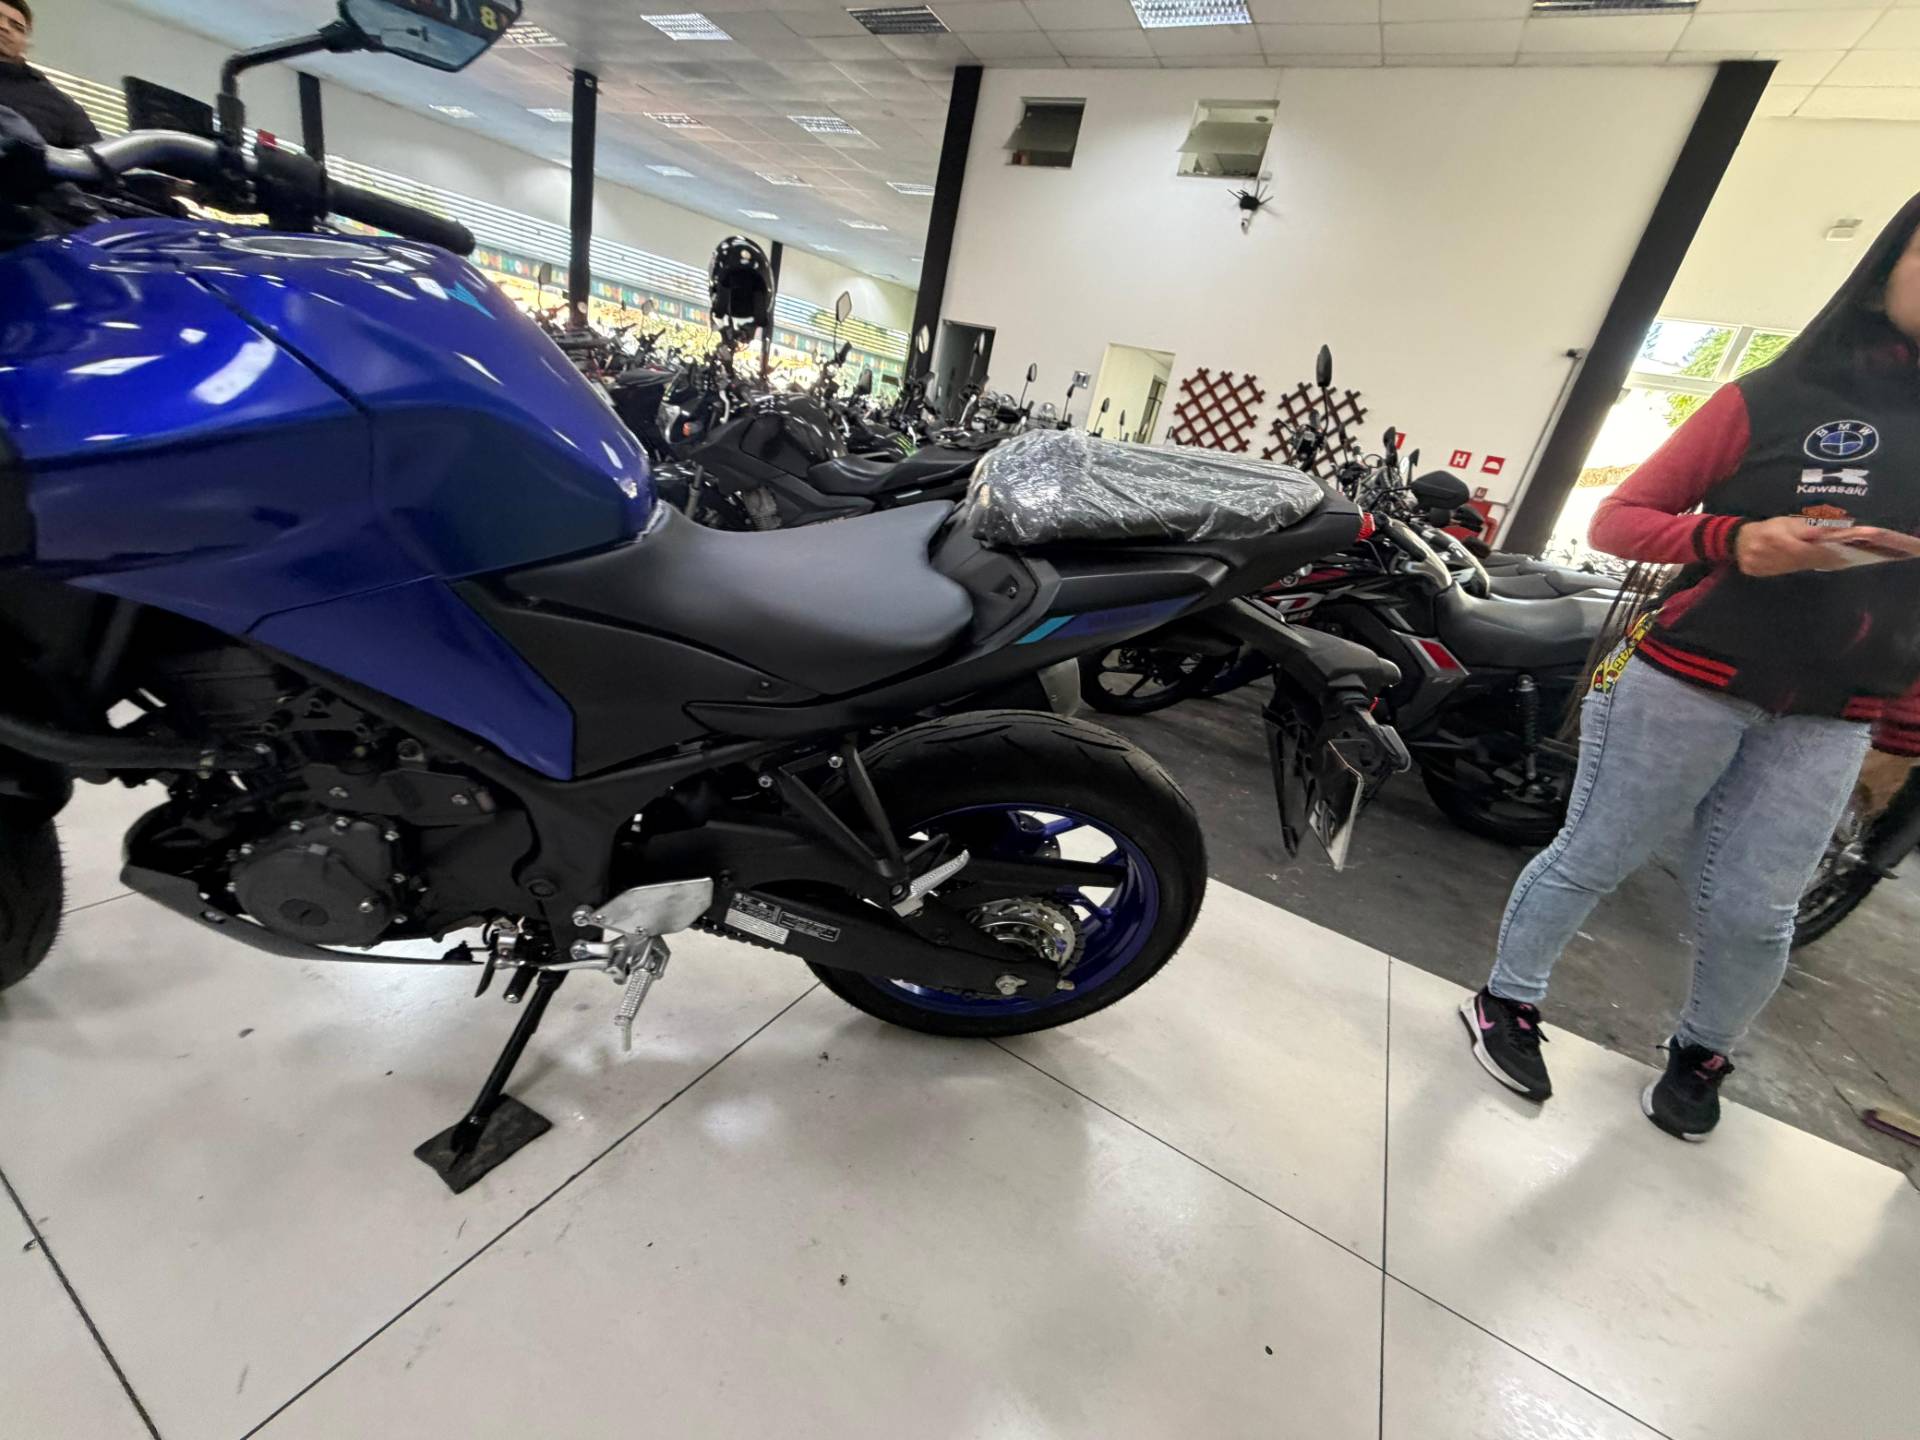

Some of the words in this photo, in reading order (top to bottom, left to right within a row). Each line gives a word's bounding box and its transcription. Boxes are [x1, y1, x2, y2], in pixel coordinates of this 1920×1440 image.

[1816, 423, 1873, 438] BMW
[1453, 452, 1467, 468] H
[1796, 484, 1868, 496] Kawasaki
